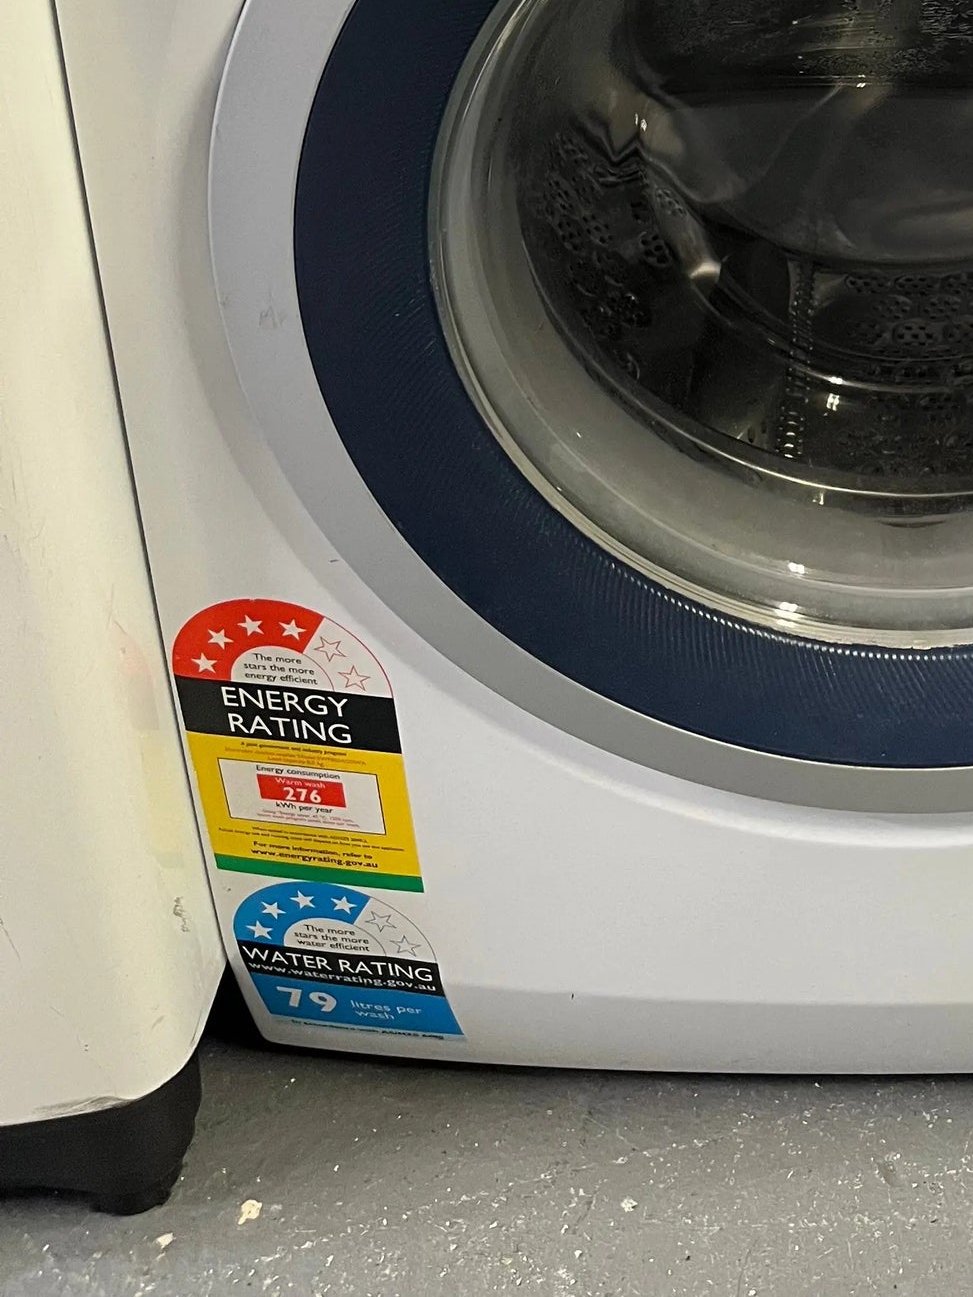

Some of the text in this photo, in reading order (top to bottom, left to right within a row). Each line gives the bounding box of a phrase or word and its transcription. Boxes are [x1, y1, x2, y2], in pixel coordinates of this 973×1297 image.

[252, 653, 302, 665] The more
[244, 663, 315, 676] stars the more
[244, 672, 319, 685] energy efficient
[220, 685, 349, 718] ENERGY
[227, 712, 353, 745] RATING
[256, 764, 341, 780] Energy consumption
[274, 776, 326, 789] Warm wash
[282, 787, 322, 804] 276
[275, 801, 333, 815] kWh per year
[253, 840, 267, 848] For
[342, 851, 361, 859] refer
[251, 848, 379, 868] www.energyrating.gov.au
[294, 931, 370, 945] stars the more
[303, 924, 356, 936] The more
[297, 939, 371, 952] water efficient
[242, 945, 434, 983] WATER RATING
[248, 961, 436, 992] www.waterrating.gov.au
[276, 985, 338, 1013] 79
[350, 999, 422, 1015] litres per
[355, 1009, 395, 1021] wash
